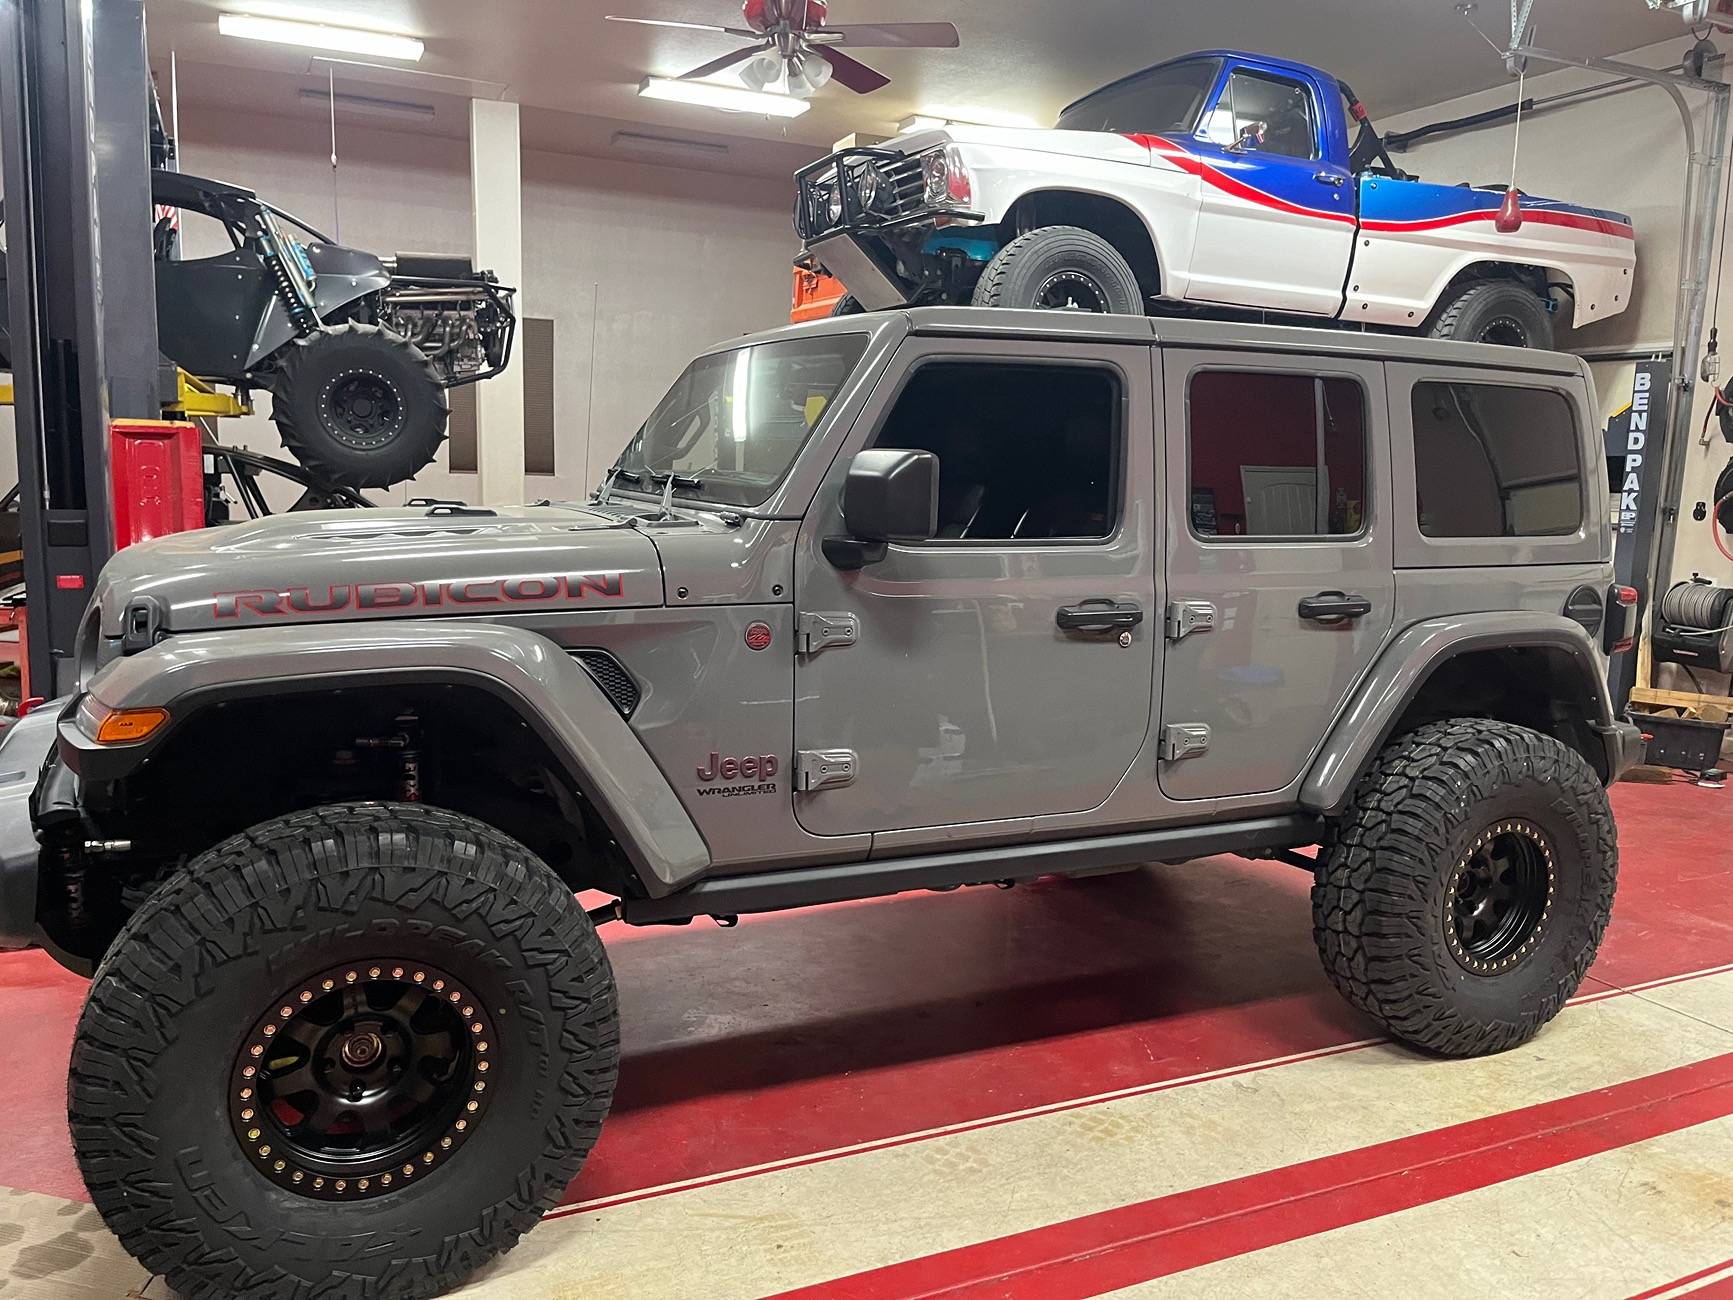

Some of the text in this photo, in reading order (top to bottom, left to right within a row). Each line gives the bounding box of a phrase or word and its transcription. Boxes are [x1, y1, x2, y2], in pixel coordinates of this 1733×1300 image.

[1620, 372, 1651, 510] BENDPAK
[213, 572, 624, 619] RUBICON
[696, 751, 779, 782] Jeep
[697, 783, 776, 796] WRANGLER
